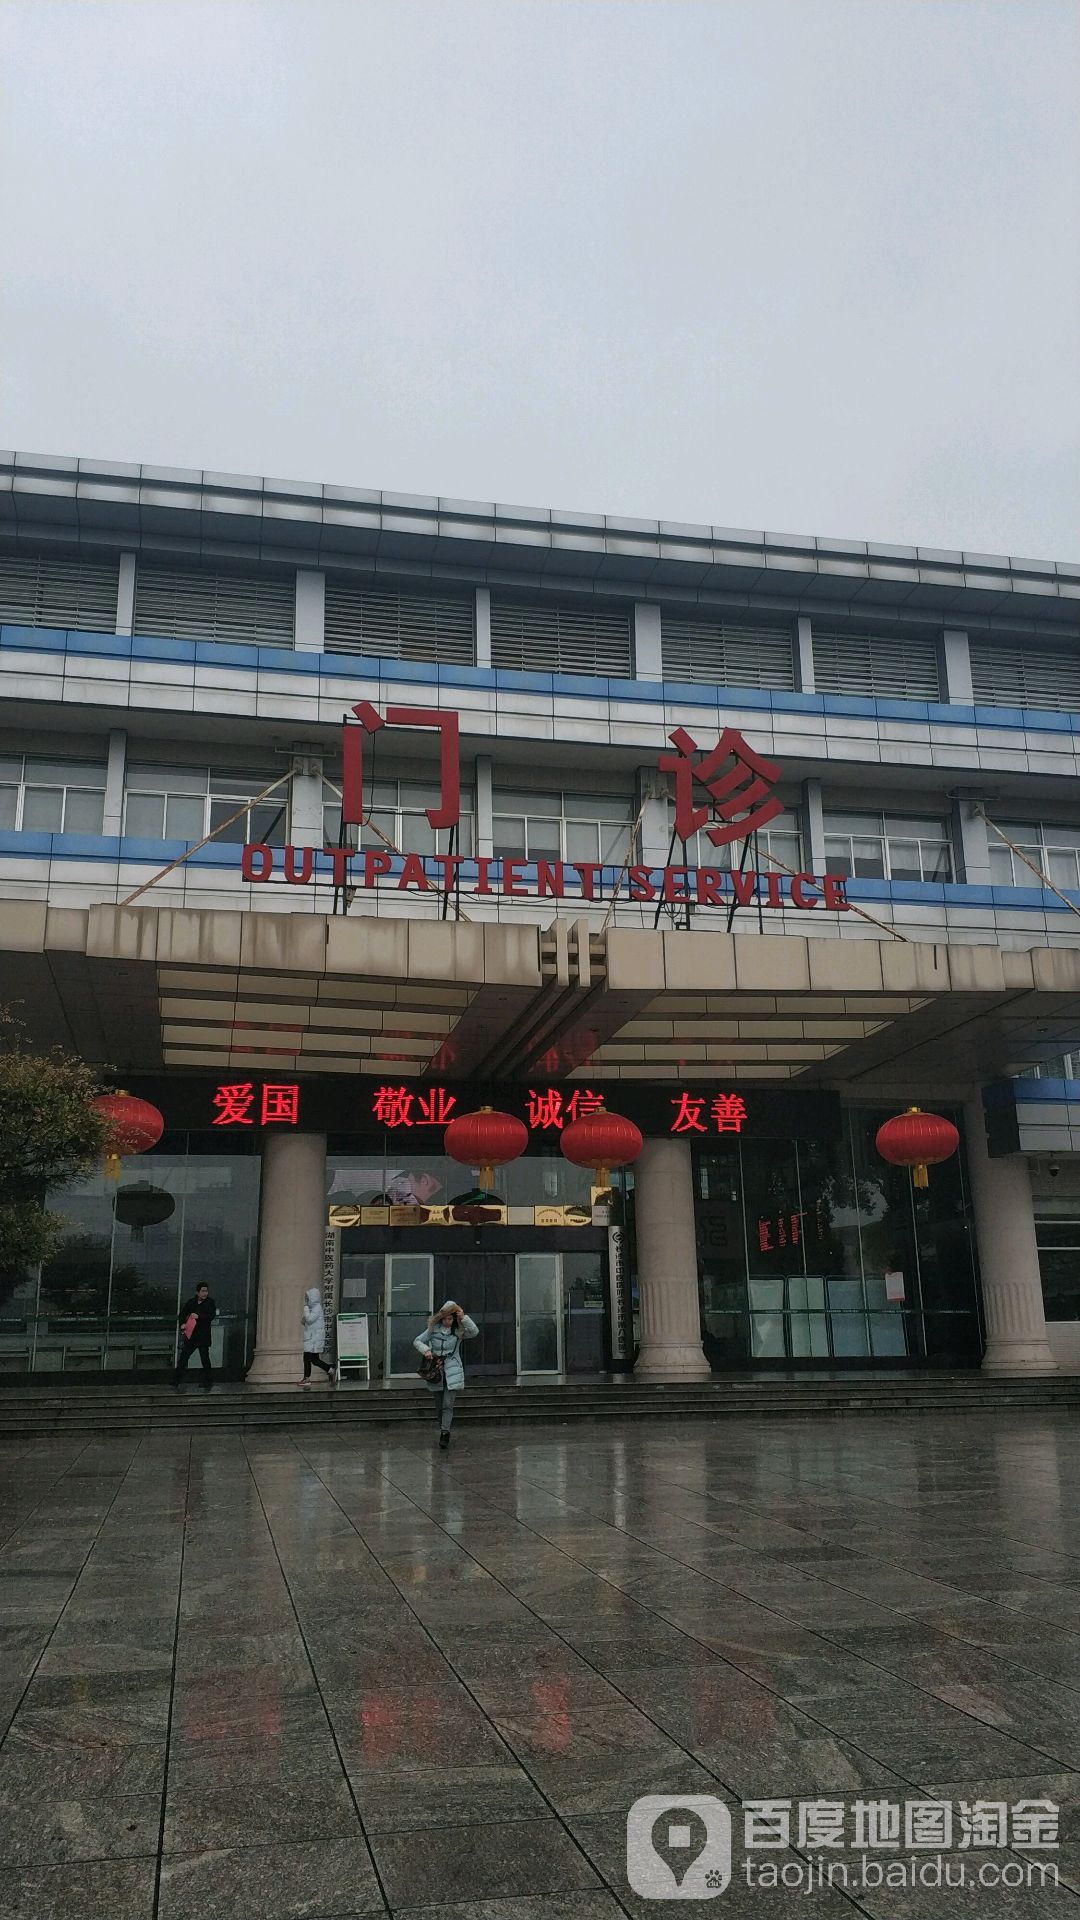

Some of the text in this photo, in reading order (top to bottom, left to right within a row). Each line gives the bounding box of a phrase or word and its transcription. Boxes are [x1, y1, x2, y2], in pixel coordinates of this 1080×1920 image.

[344, 701, 785, 846] 门诊
[241, 843, 852, 911] OUTPATIENT SERVICE
[212, 1083, 748, 1133] 爱国 敬业 诚信 友善
